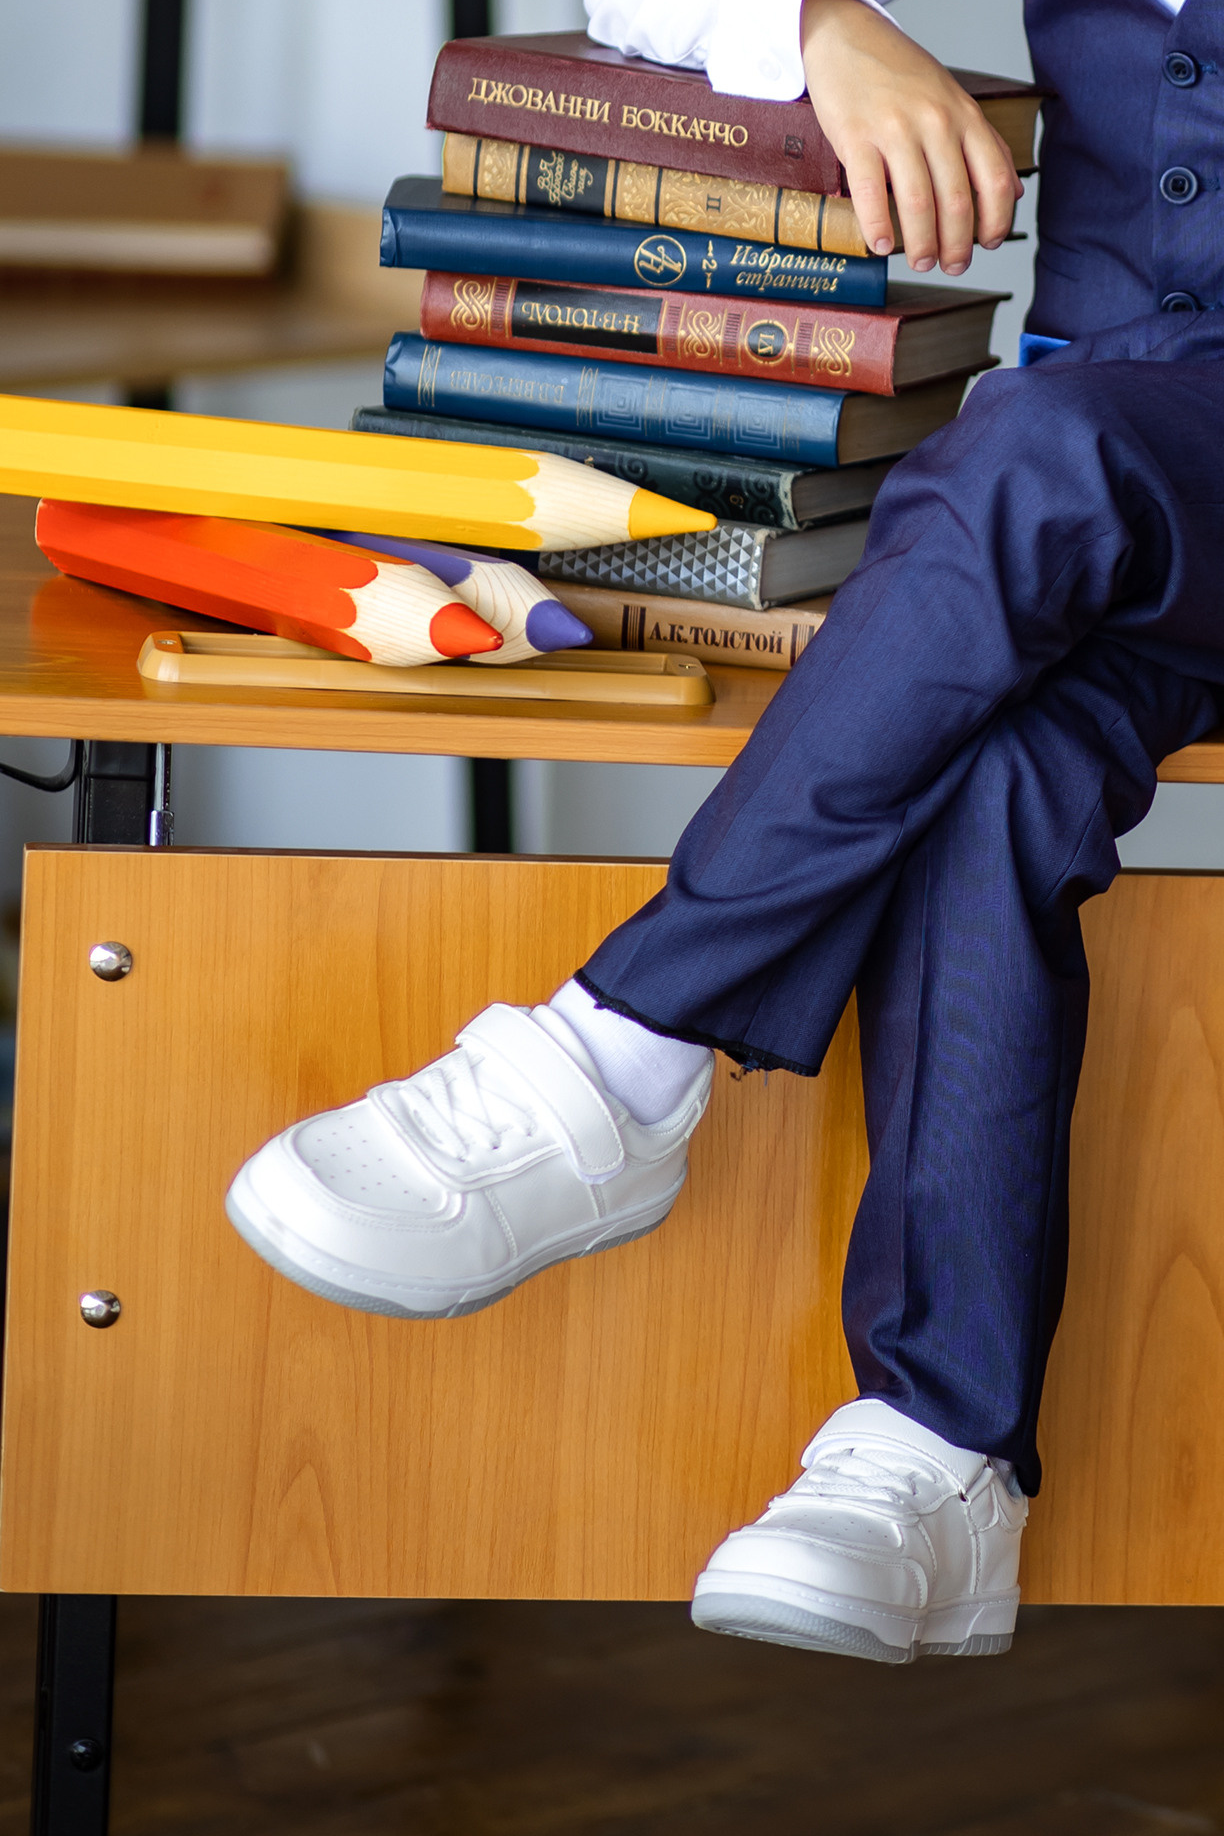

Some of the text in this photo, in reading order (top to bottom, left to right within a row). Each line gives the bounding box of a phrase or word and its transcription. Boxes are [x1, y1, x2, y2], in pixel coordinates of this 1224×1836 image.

[467, 77, 748, 148] ДЖОВАННИ БОККАЧЧО
[730, 245, 847, 273] Избранные
[736, 271, 838, 295] страницы
